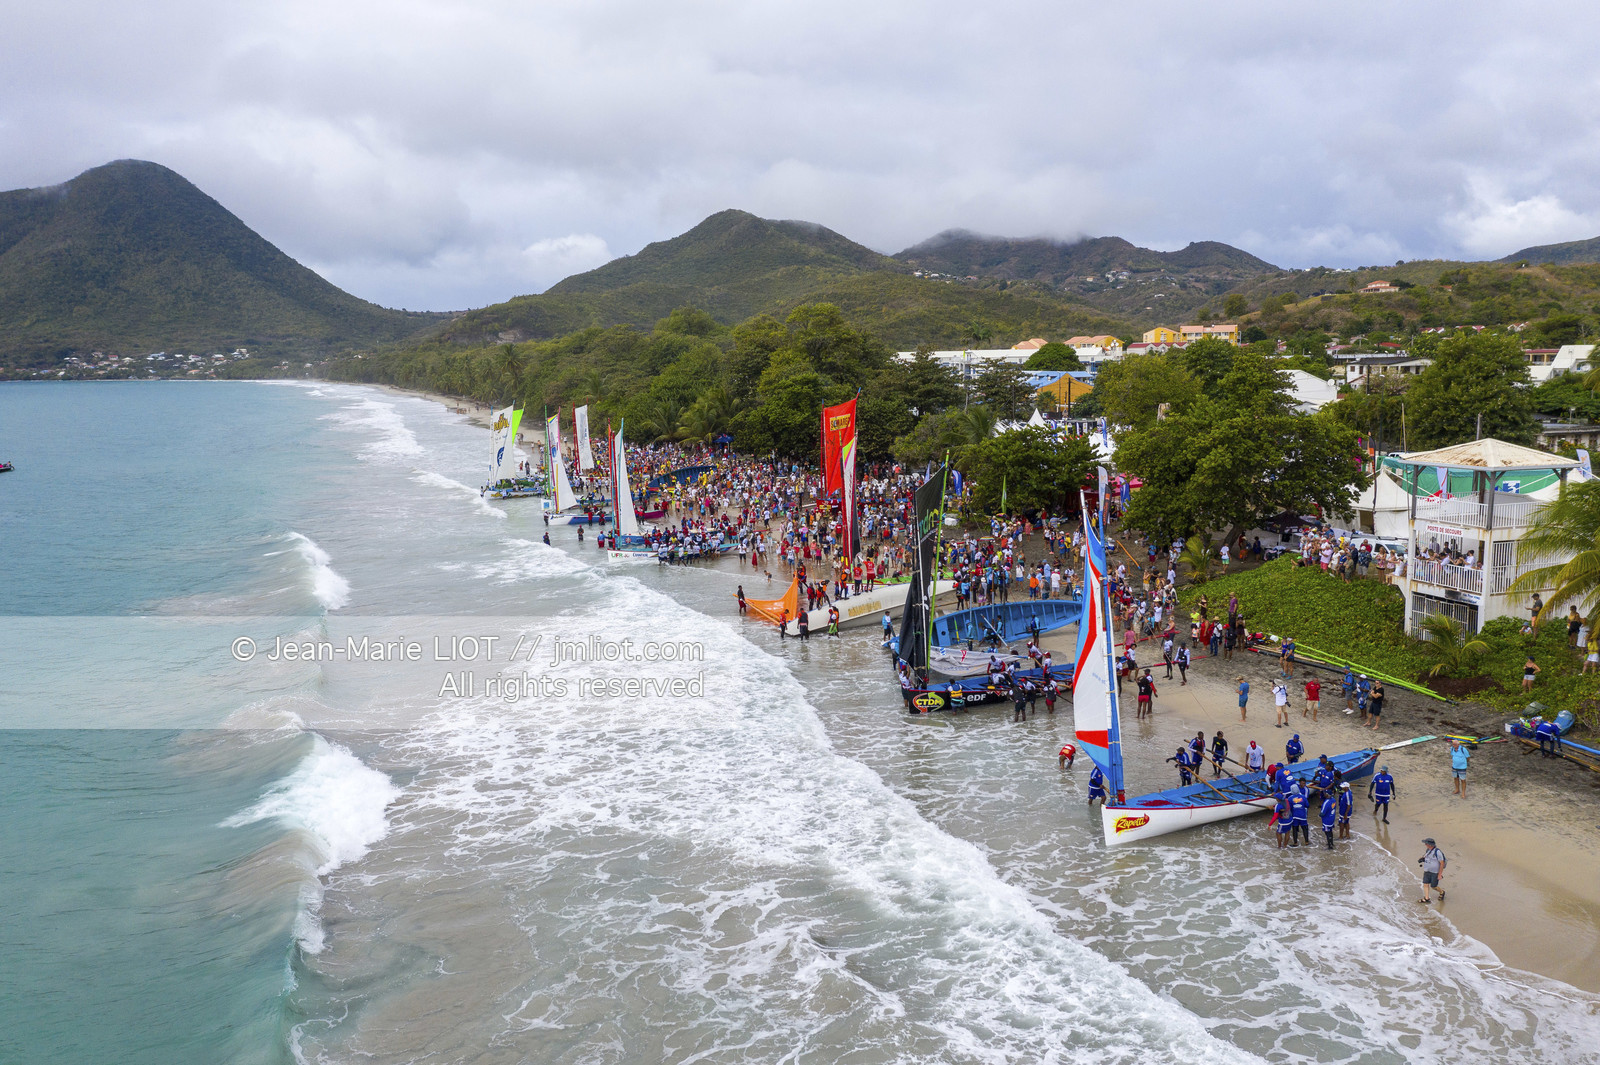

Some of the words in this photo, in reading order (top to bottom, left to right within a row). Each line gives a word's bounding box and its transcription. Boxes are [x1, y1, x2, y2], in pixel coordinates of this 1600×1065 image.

[1427, 525, 1439, 533] POSTE
[1445, 528, 1462, 536] SECOURS
[915, 698, 942, 706] CTDM
